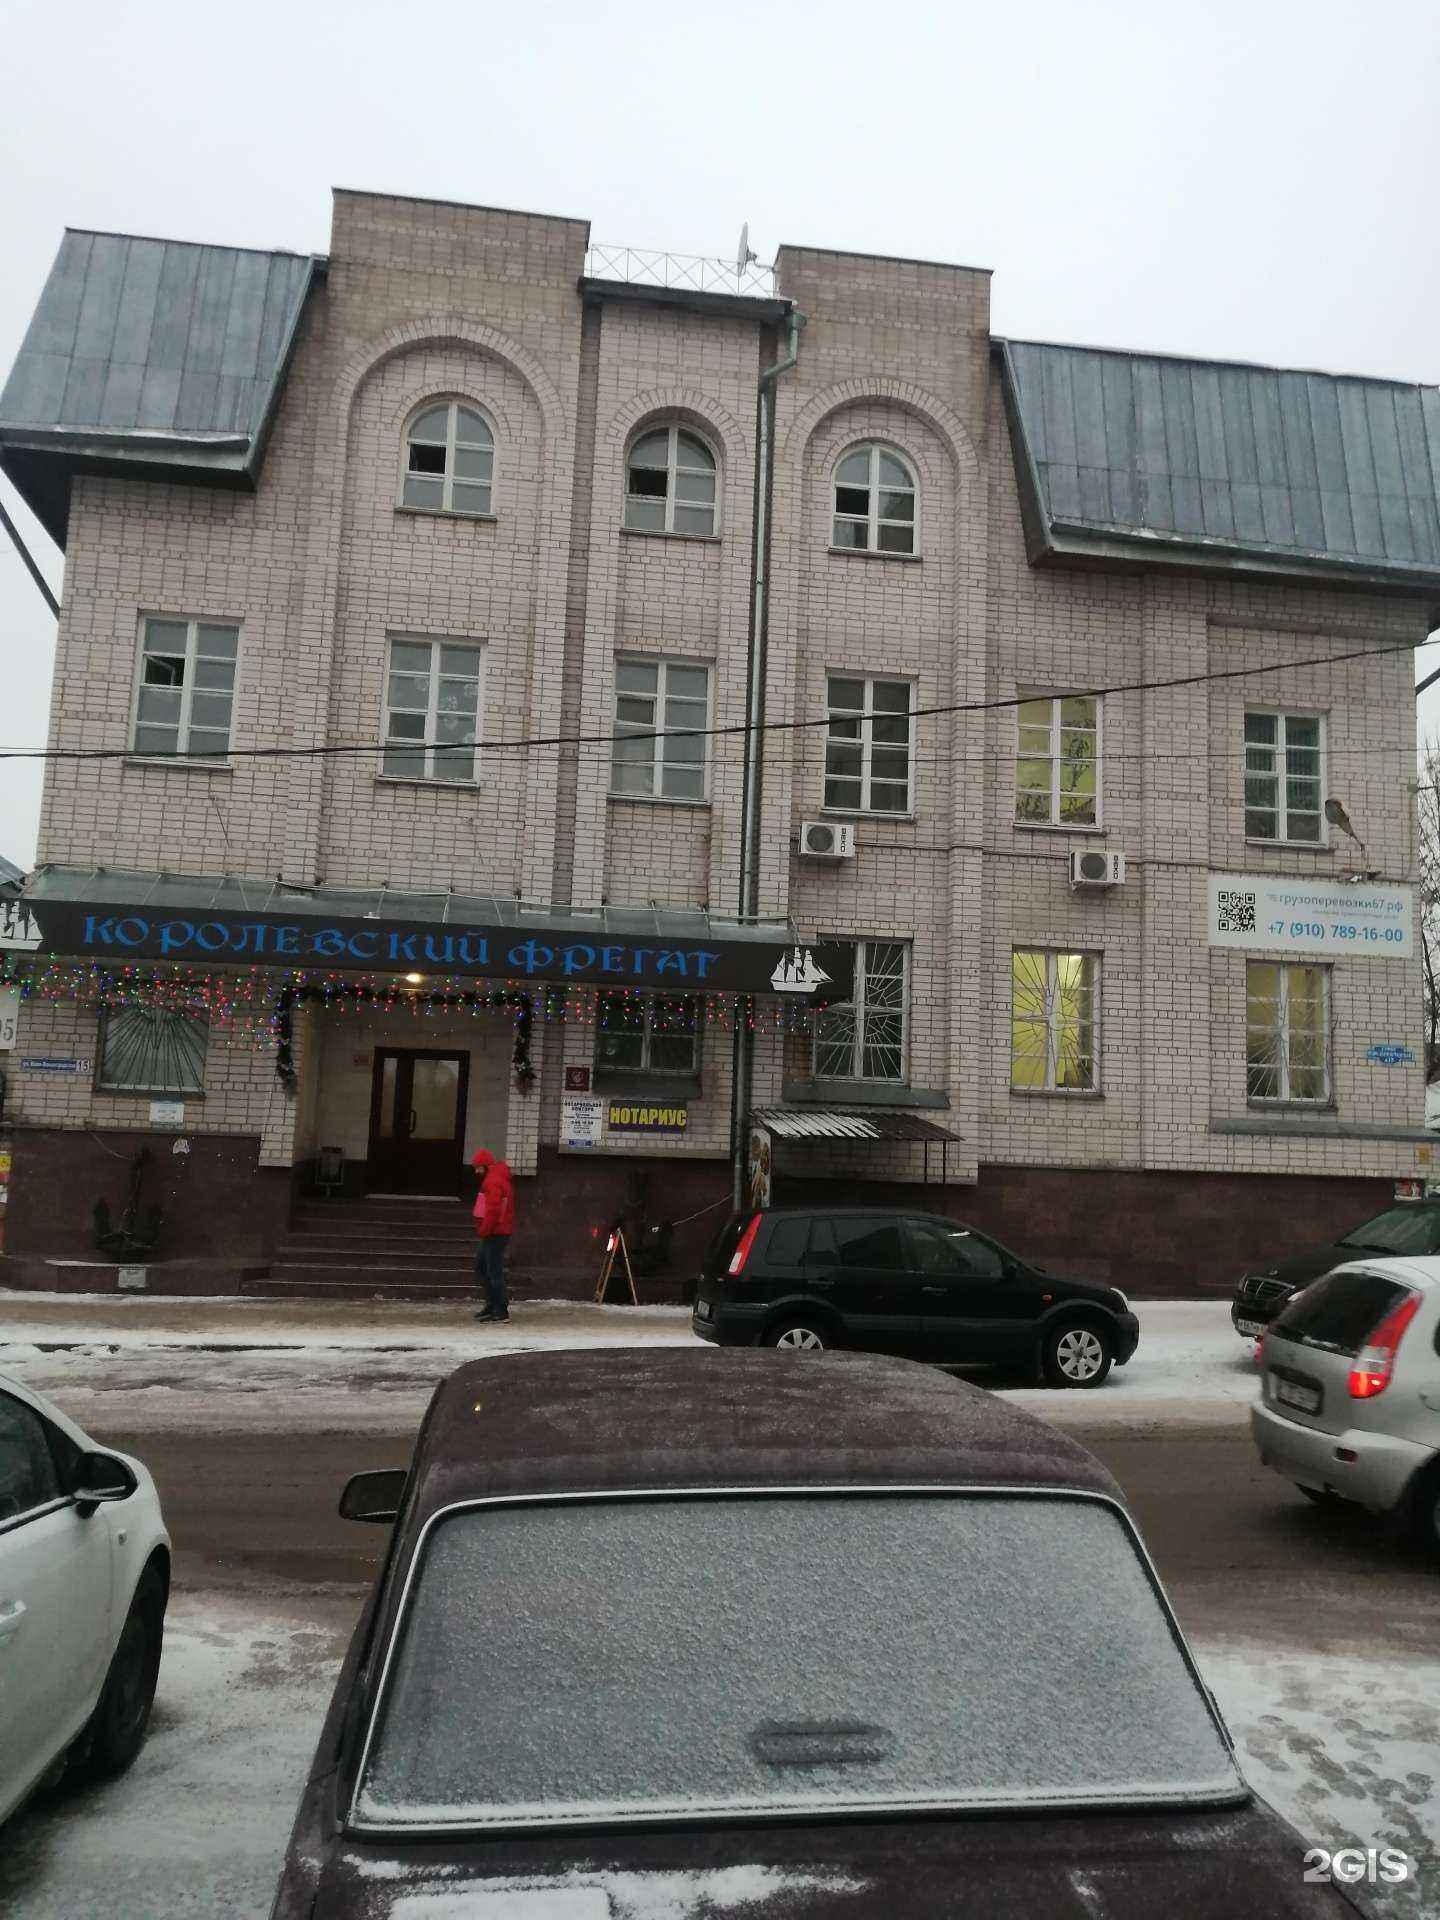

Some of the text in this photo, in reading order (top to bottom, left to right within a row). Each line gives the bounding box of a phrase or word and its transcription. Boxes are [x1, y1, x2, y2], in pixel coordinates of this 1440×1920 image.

[1268, 921, 1404, 942] +7 (910) 789-16-00
[82, 914, 721, 978] КОРОЛЕВСКИЙ ФРЕГАТ
[609, 1107, 688, 1126] НОТАРИУС
